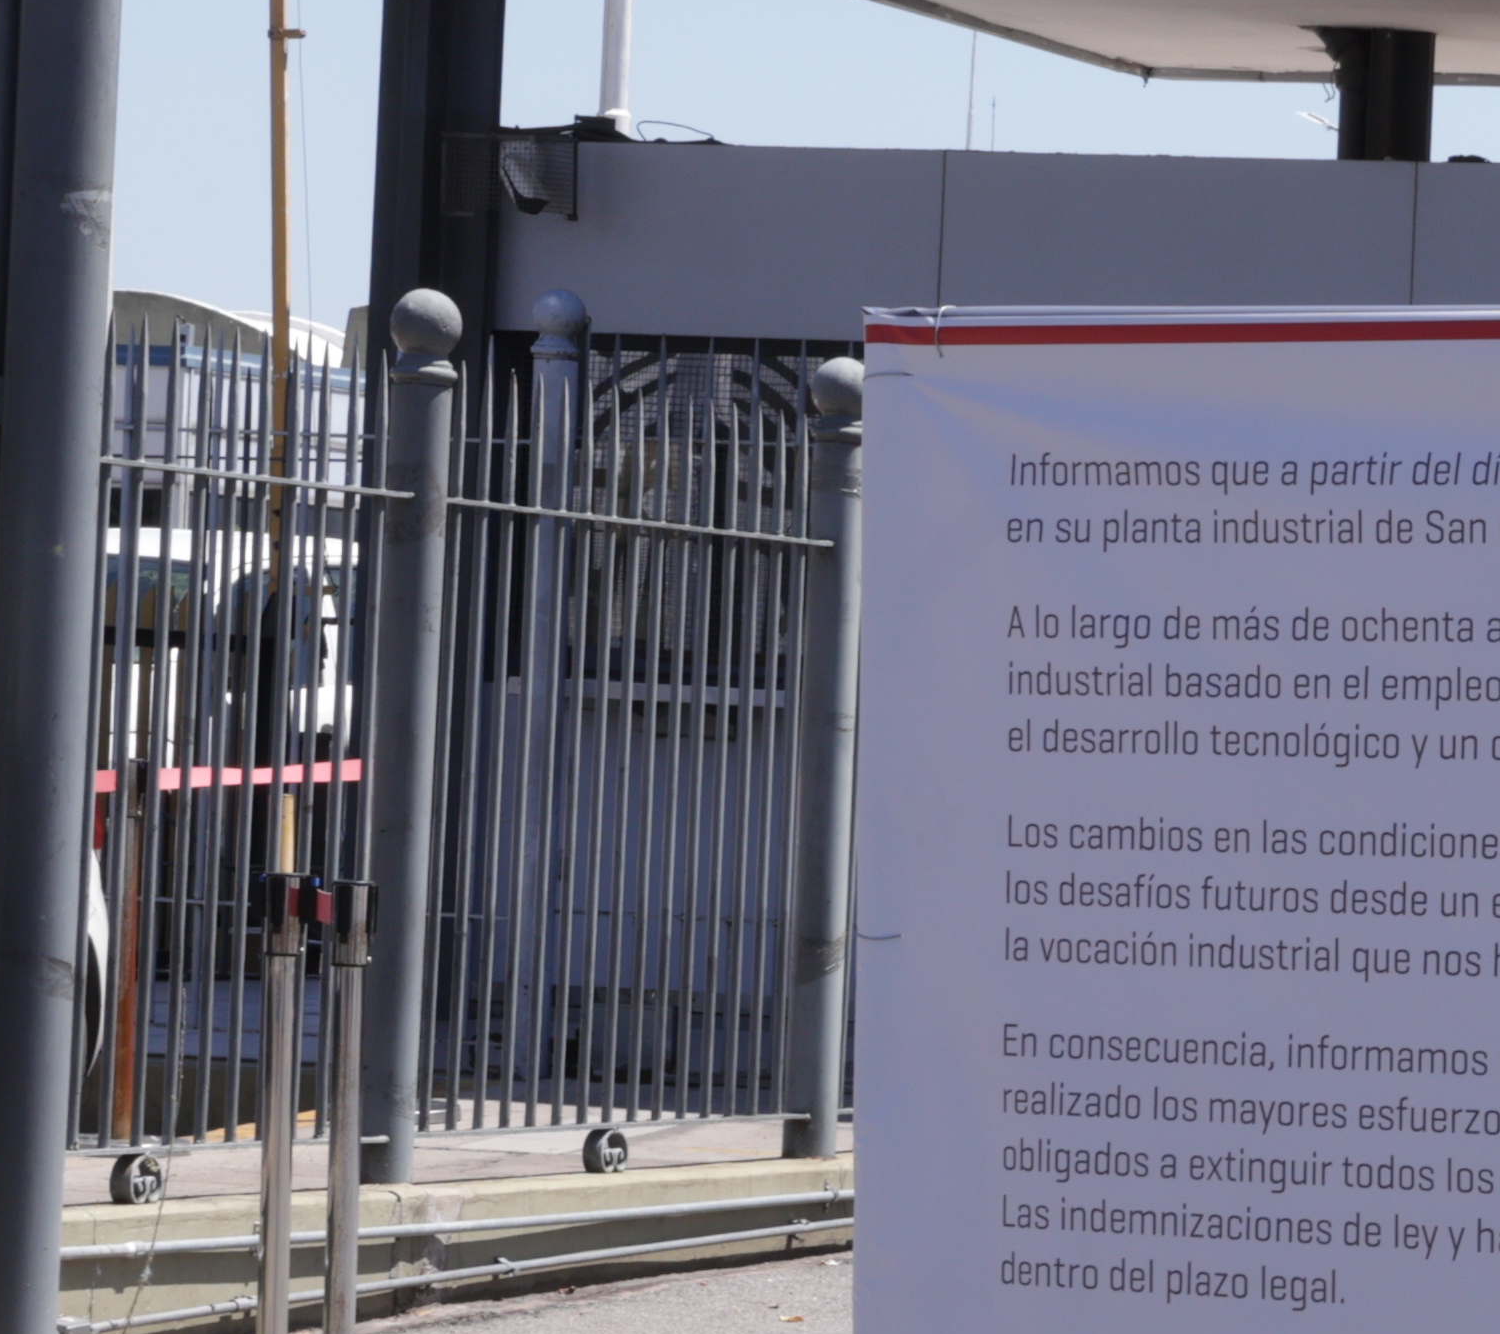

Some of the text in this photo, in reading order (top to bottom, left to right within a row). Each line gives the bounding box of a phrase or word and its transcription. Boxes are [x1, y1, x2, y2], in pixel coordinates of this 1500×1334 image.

[1010, 451, 1201, 487] Informamos
[1211, 460, 1270, 496] que
[1280, 460, 1299, 487] a
[1309, 451, 1403, 496] partir
[1411, 451, 1462, 486] del
[1006, 517, 1044, 544] en
[1055, 518, 1091, 544] su
[1102, 509, 1201, 553] planta
[1213, 509, 1363, 545] industrial
[1375, 509, 1413, 545] de
[1425, 509, 1487, 545] San
[1007, 605, 1026, 638] A
[1035, 604, 1059, 639] lo
[1071, 604, 1151, 649] largo
[1163, 605, 1201, 641] de
[1212, 605, 1280, 642] más
[1291, 606, 1330, 642] de
[1341, 607, 1474, 643] ochenta
[1008, 661, 1153, 698] industrial
[1165, 663, 1282, 700] basado
[1293, 673, 1331, 700] en
[1343, 665, 1370, 701] el
[1008, 718, 1031, 753] el
[1042, 718, 1199, 756] desarrollo
[1209, 722, 1400, 768] tecnológico
[1411, 734, 1429, 769] y
[1439, 734, 1478, 761] un
[1007, 814, 1058, 849] Los
[1069, 816, 1203, 853] cambios
[1214, 827, 1250, 854] en
[1262, 819, 1307, 856] las
[1005, 870, 1048, 906] los
[1058, 872, 1191, 910] desafíos
[1201, 875, 1319, 914] futuros
[1330, 879, 1428, 917] desde
[1440, 892, 1479, 918] un
[1003, 1023, 1038, 1058] En
[1049, 1031, 1275, 1072] consecuencia,
[1287, 1033, 1488, 1077] informamos
[1003, 1081, 1141, 1120] realizado
[1153, 1086, 1198, 1123] los
[1209, 1097, 1347, 1135] mayores
[1002, 1194, 1050, 1231] Las
[1061, 1196, 1332, 1246] indemnizaciones
[1343, 1212, 1382, 1248] de
[1394, 1213, 1439, 1260] ley
[1447, 1226, 1466, 1261] y
[1001, 1251, 1345, 1312] dentro del plazo legal.
